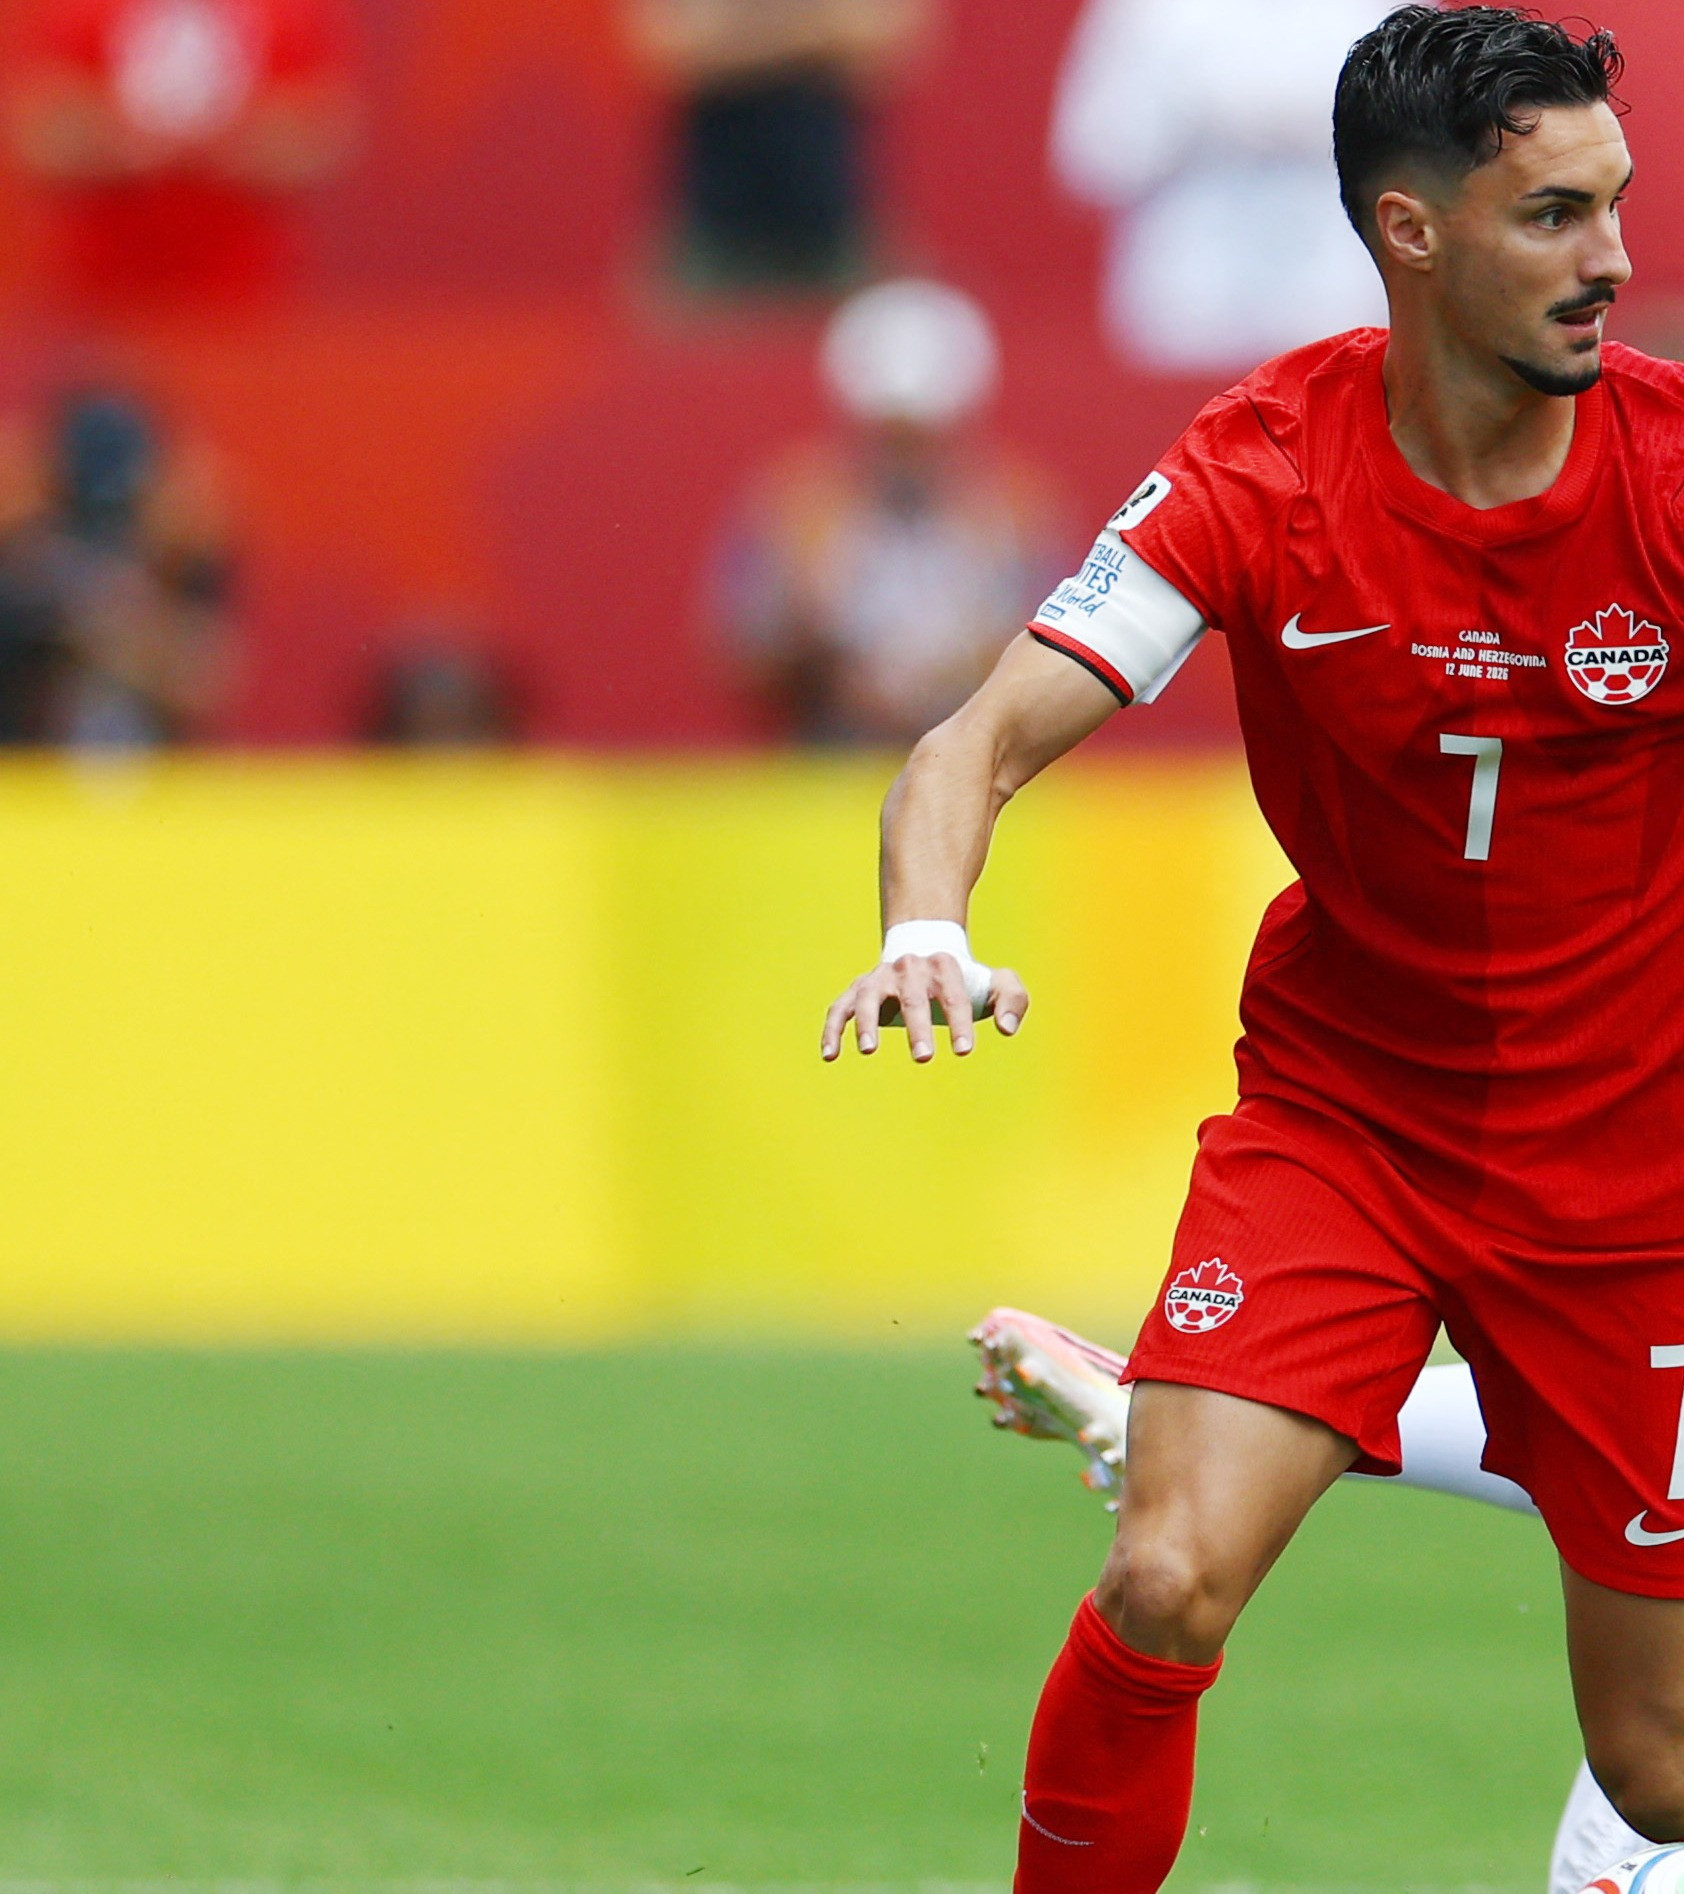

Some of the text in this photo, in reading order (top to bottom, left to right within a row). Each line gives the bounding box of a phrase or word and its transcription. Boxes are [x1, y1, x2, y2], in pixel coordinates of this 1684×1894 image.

[1458, 630, 1501, 645] CANADA
[1411, 643, 1547, 668] BOSNIA AND HERZEGOVINA
[1567, 649, 1664, 666] CANADA
[1445, 663, 1509, 680] 12 JUNE 2026
[1439, 733, 1503, 861] 7
[1168, 1289, 1236, 1307] CANADA
